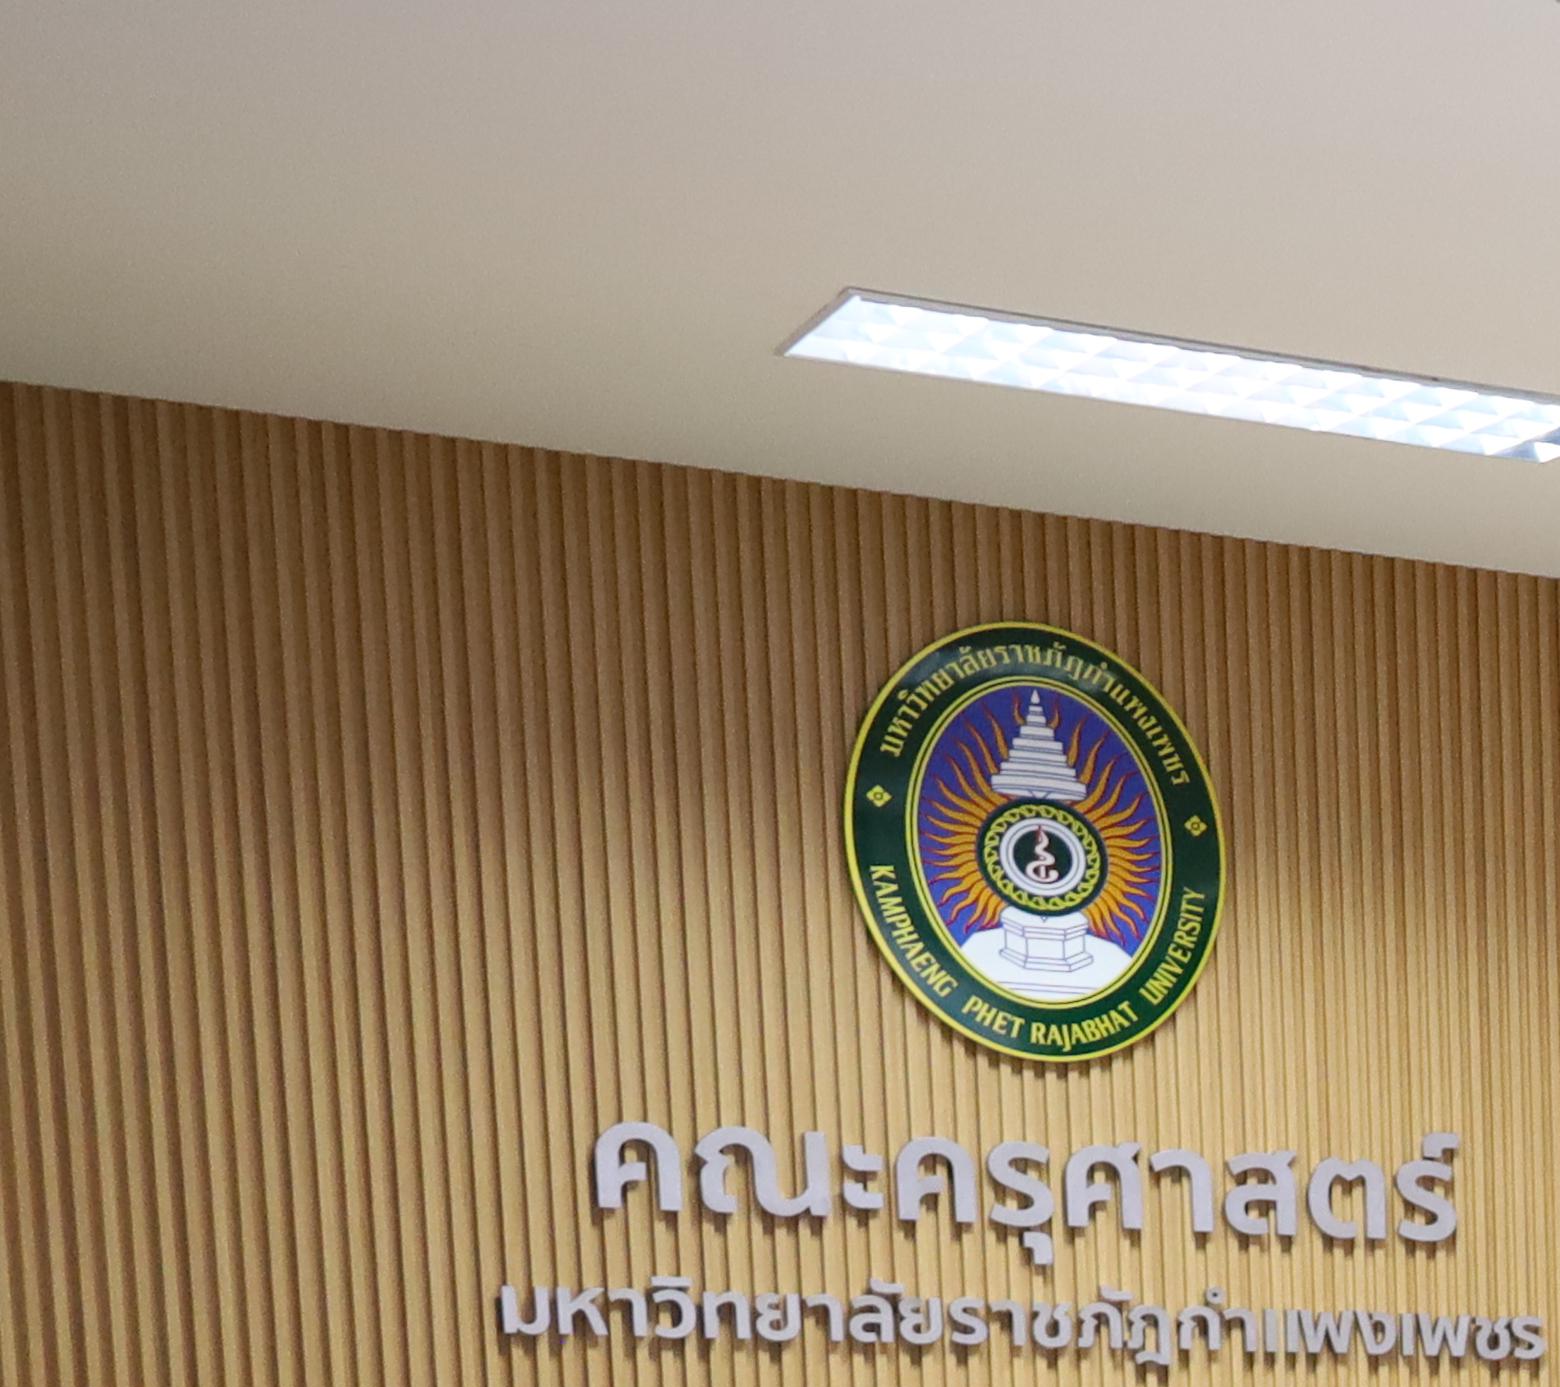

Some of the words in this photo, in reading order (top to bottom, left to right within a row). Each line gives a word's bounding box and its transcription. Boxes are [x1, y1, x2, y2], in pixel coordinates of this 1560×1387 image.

[869, 865, 959, 998] KAMPHAENG
[961, 994, 1026, 1039] PHET
[1030, 1001, 1139, 1052] RAJABHAT
[1138, 886, 1206, 1006] UNIVERSITY
[594, 1120, 1461, 1266] คณะครุศาสตร์
[500, 1275, 1548, 1367] มหาวิทยาลัยราชภัฏกำแพงเพชร
